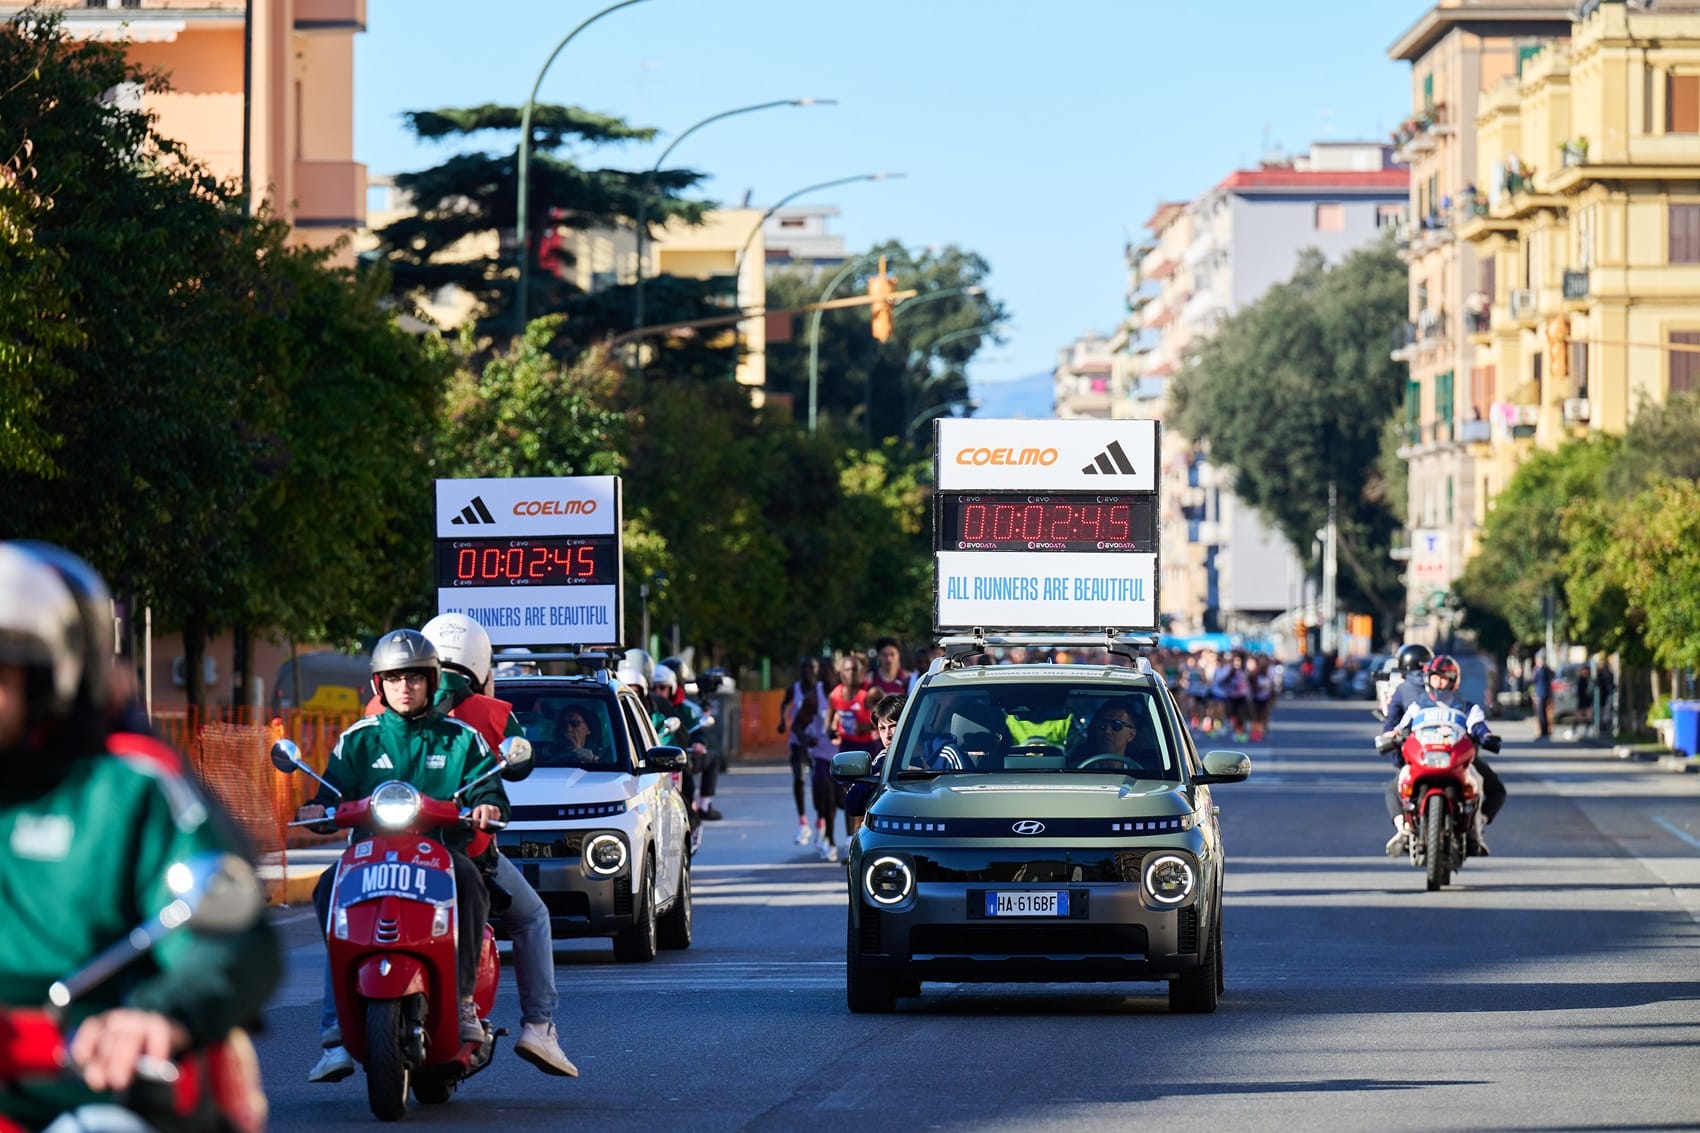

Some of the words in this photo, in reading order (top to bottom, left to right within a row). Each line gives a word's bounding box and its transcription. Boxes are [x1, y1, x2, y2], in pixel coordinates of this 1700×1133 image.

[955, 447, 1059, 466] COELMO
[512, 499, 597, 516] COELMO
[963, 505, 1129, 540] 00:02:45
[458, 547, 595, 579] 00:02:45
[947, 576, 969, 600] ALL
[974, 576, 1038, 601] RUNNERS
[1043, 577, 1069, 601] ARE
[1074, 577, 1145, 602] BEAUTIFUL
[525, 606, 546, 626] ARE
[550, 605, 608, 626] BEAUTIFUL
[362, 863, 410, 893] MOTO
[414, 868, 426, 894] 4
